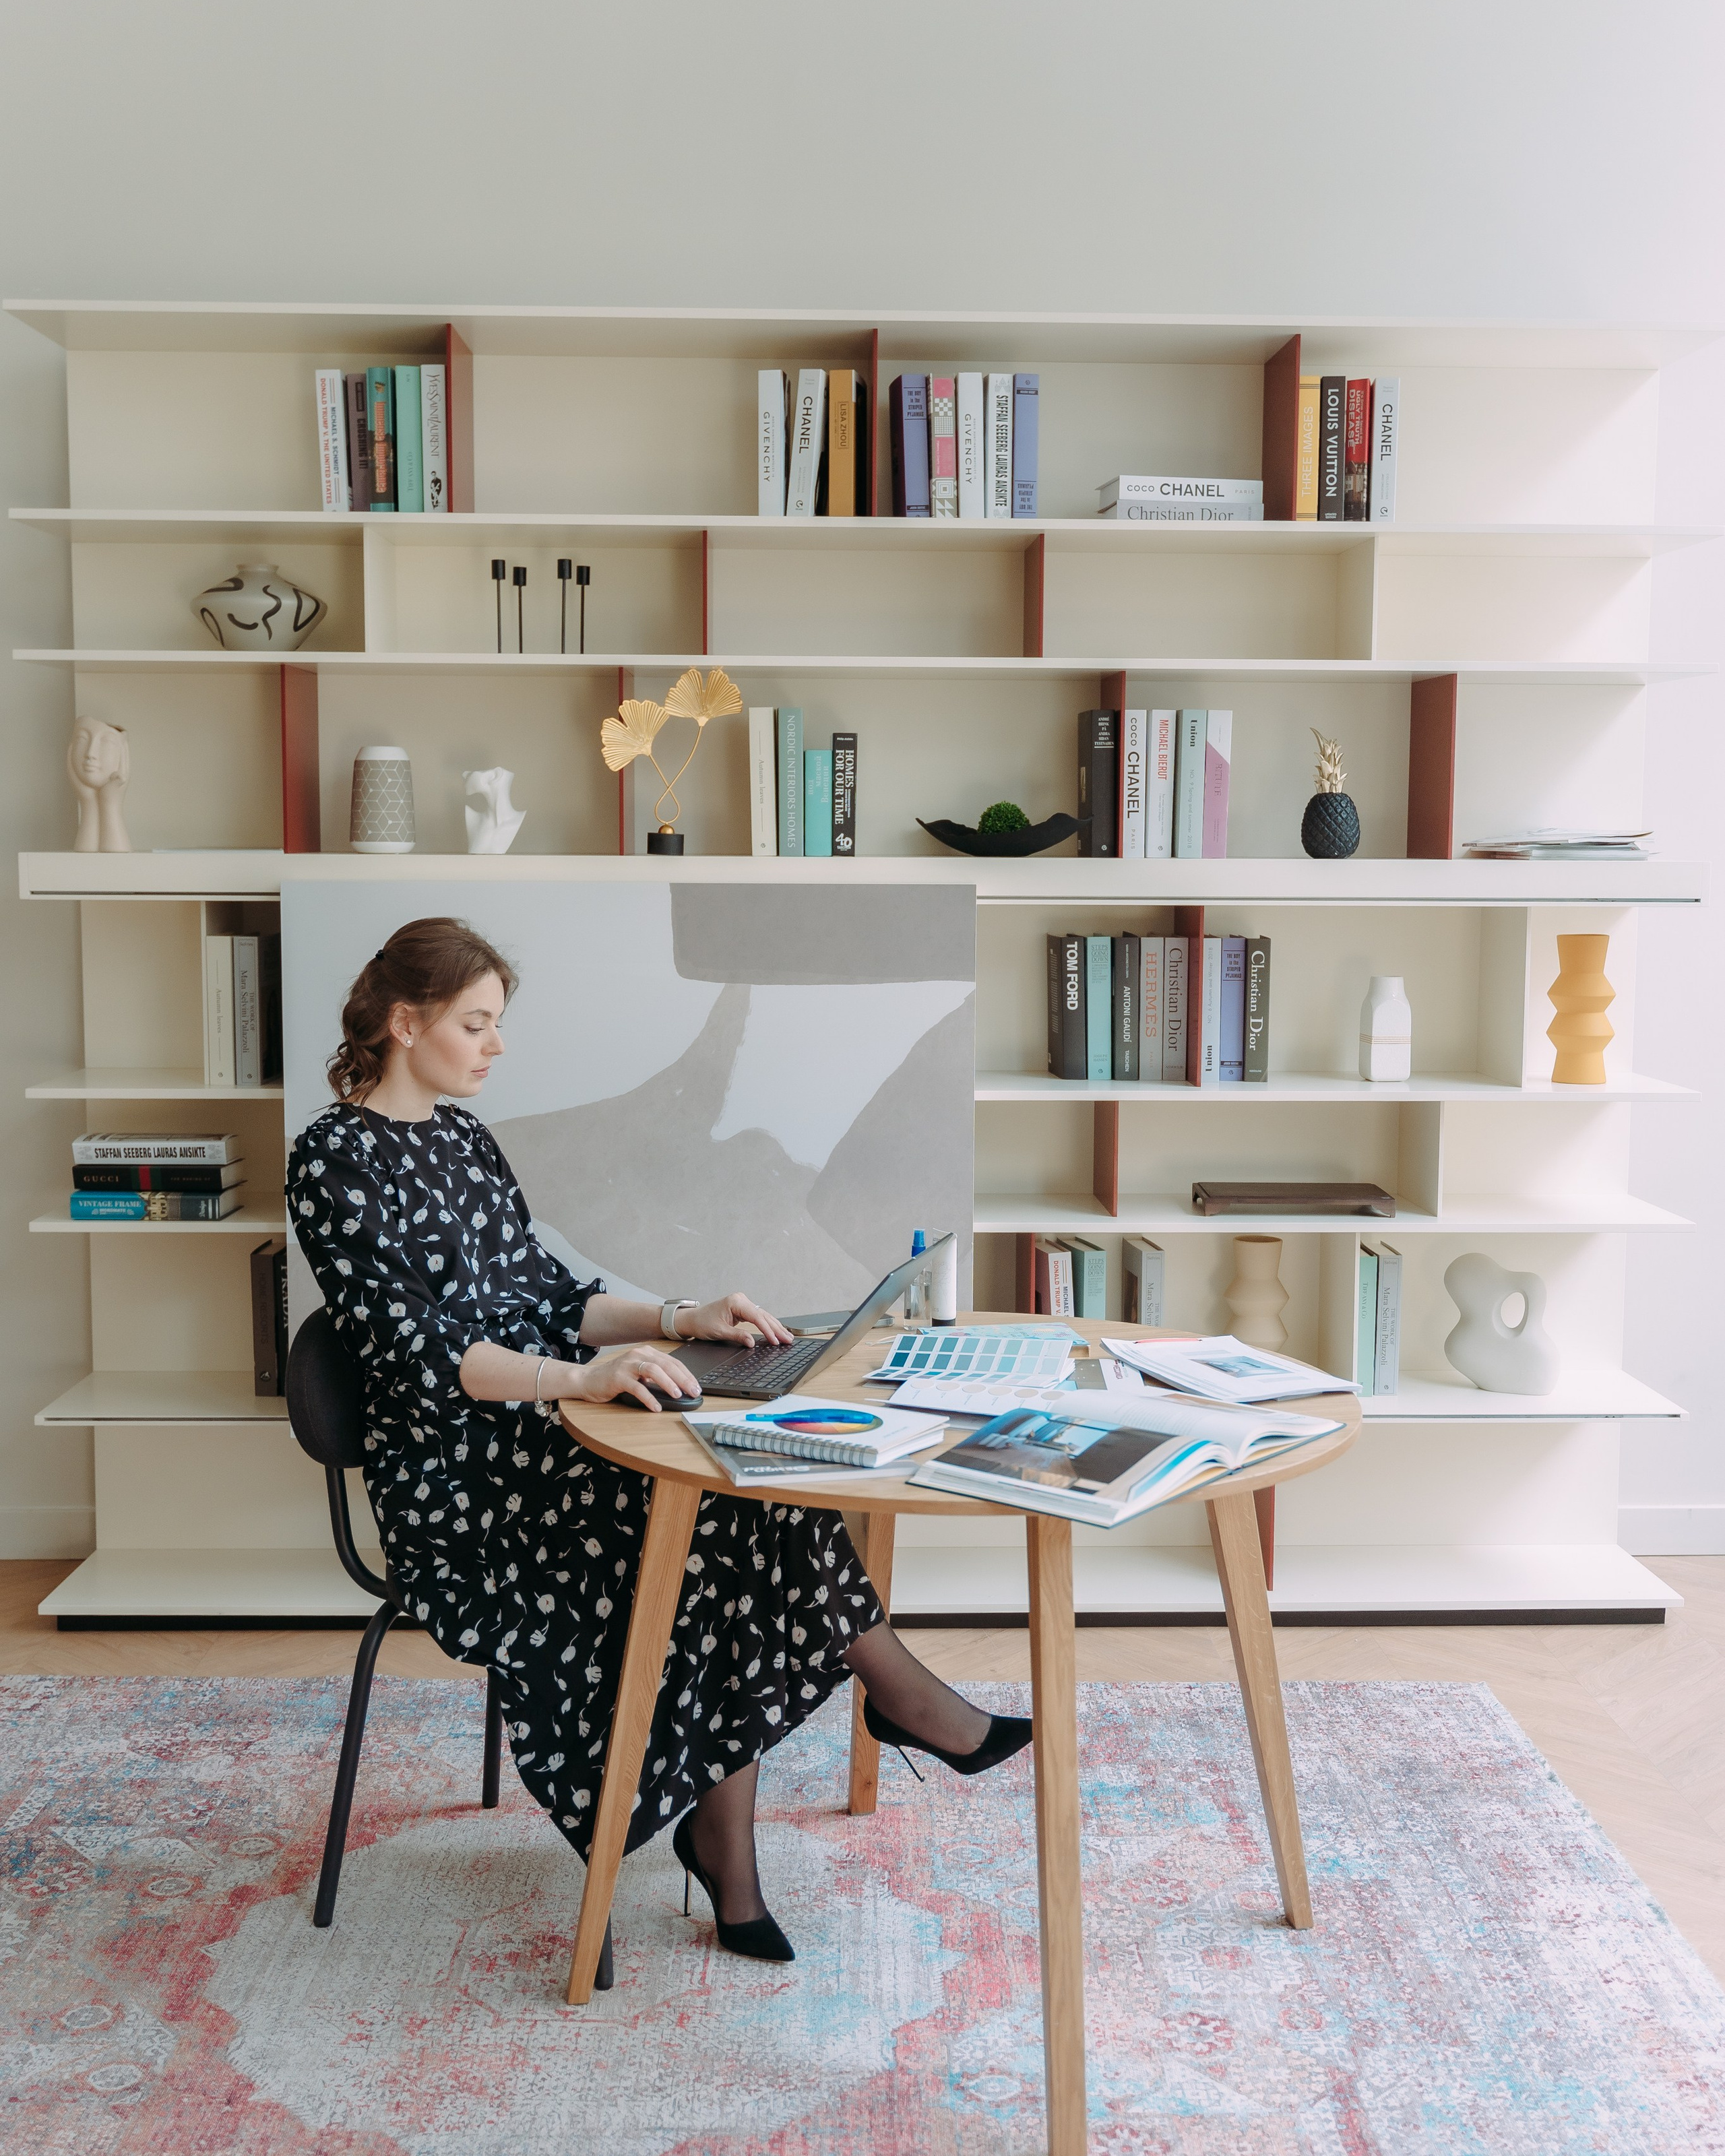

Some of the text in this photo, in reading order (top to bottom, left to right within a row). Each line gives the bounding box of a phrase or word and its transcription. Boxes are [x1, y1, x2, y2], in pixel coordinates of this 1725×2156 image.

[356, 418, 368, 457] CRUSHING
[798, 396, 813, 454] CHANEL
[995, 395, 1008, 506] STAFFAN SEEBERG LAURAS ANSIKTE
[1302, 407, 1313, 497] THREE IMAGES
[1325, 389, 1339, 497] LOUIS VUITTON
[1381, 404, 1393, 461] CHANEL
[1127, 506, 1194, 520] Christian
[1200, 508, 1234, 521] Dior
[1160, 483, 1224, 497] CHANEL
[845, 750, 854, 787] HOMES
[1158, 720, 1169, 780] MICHAEL BIERUT
[836, 750, 844, 824] FOR OUR TIME
[1127, 752, 1139, 818] CHANEL
[1067, 942, 1078, 1010] TOM FORD
[1168, 948, 1183, 1051] Christian Dior
[1249, 951, 1265, 1050] Christian Dior
[1123, 1018, 1132, 1042] GAUDÍ
[95, 1147, 206, 1158] STAFFAN SEEBERG LAURAS ANSIKTE
